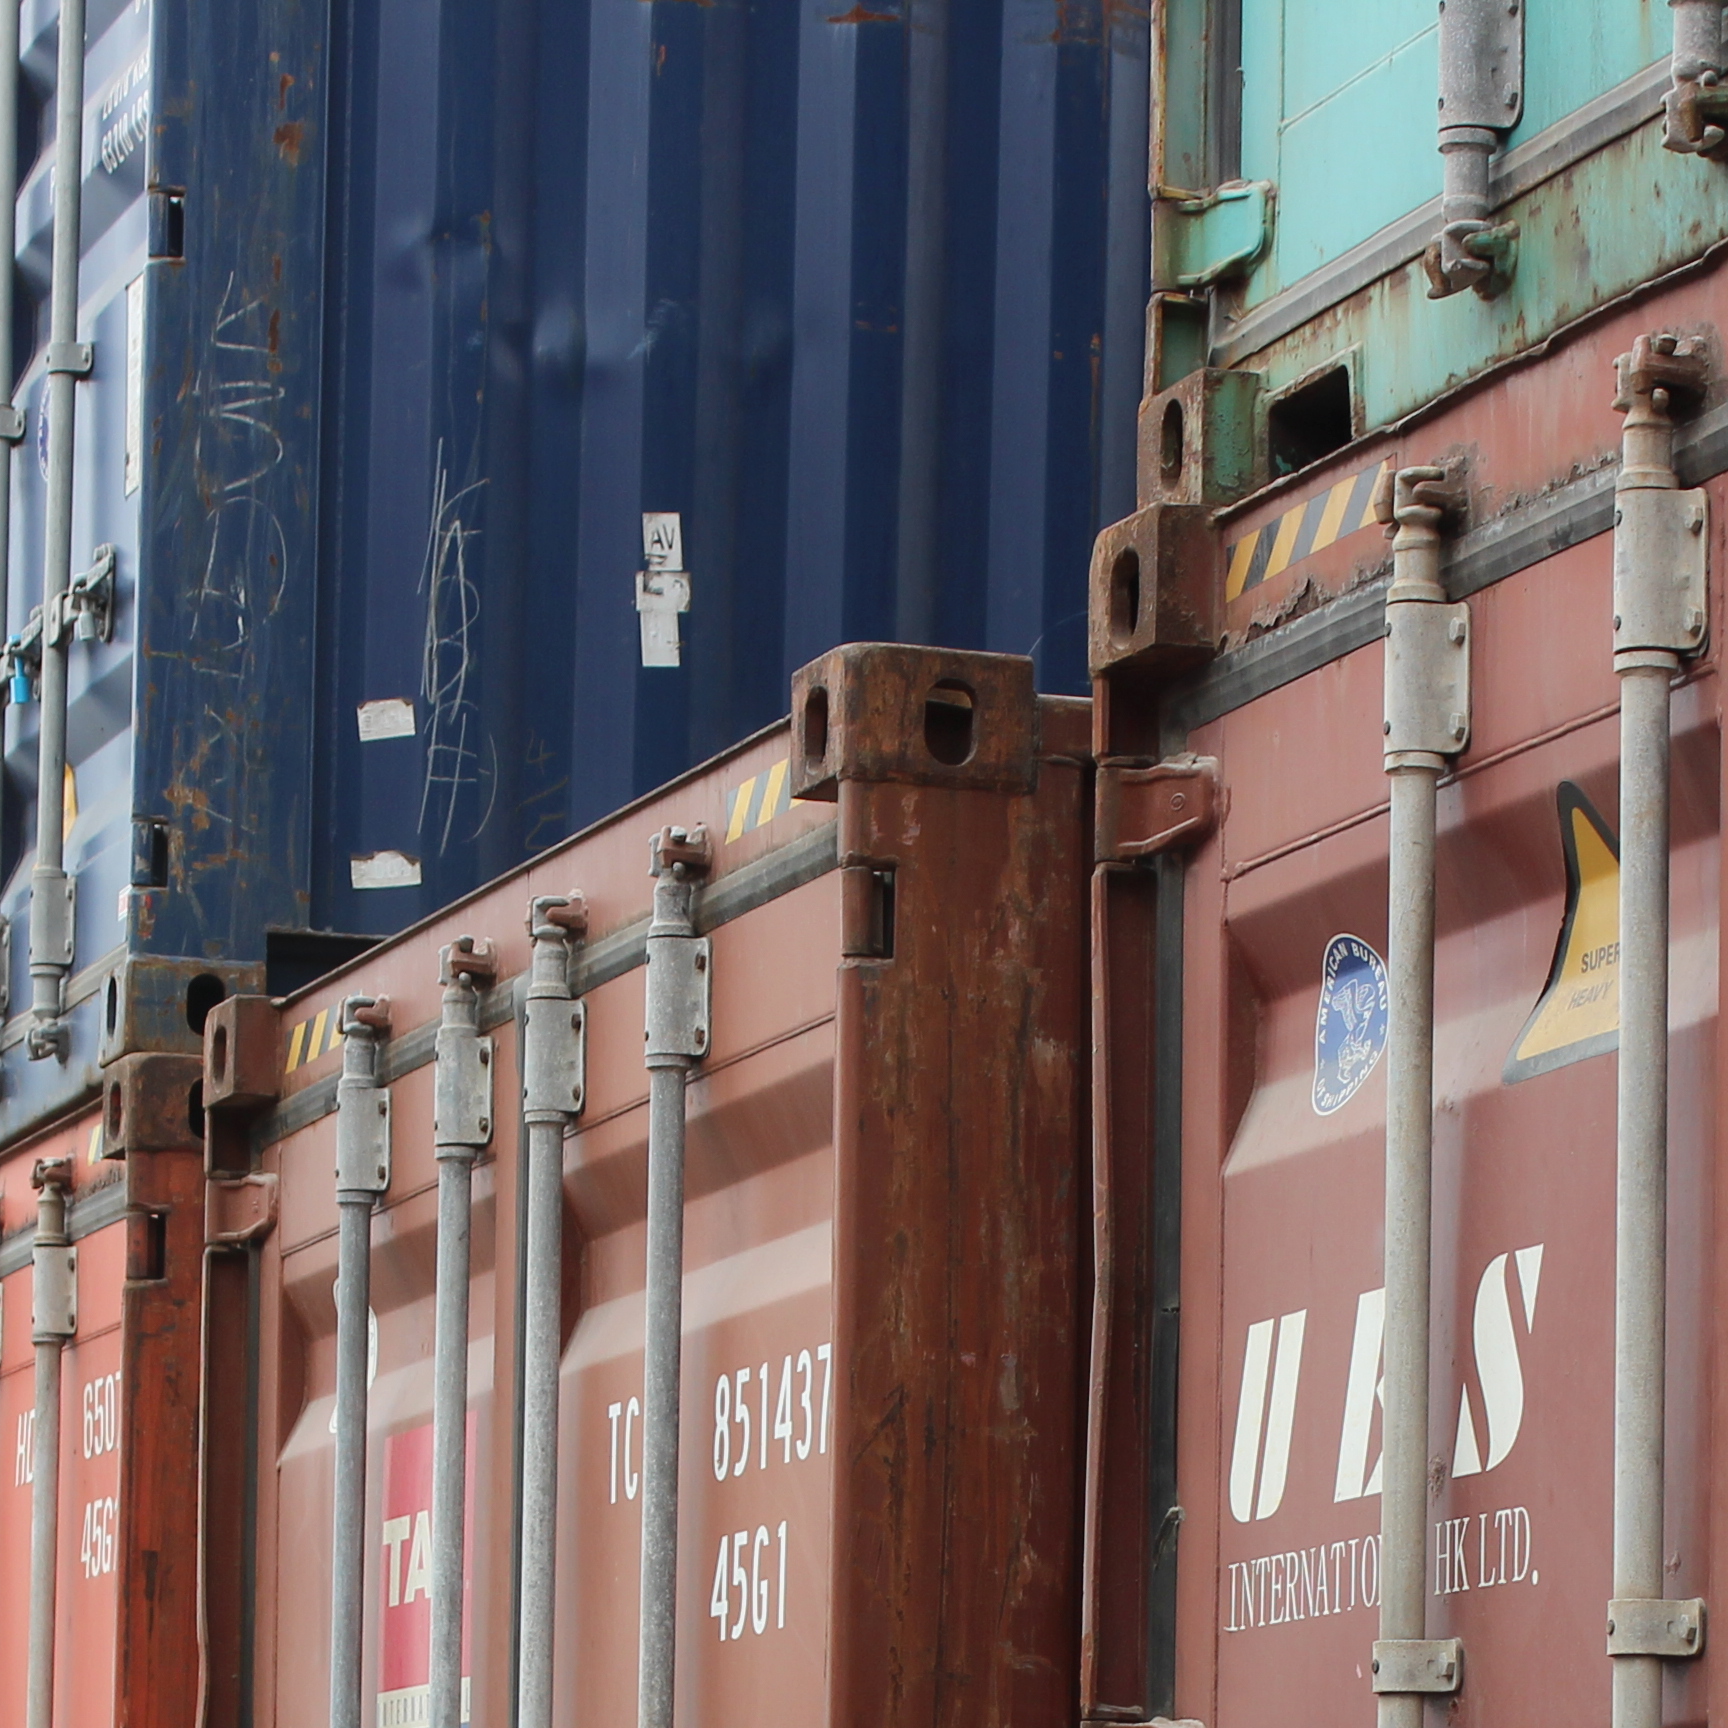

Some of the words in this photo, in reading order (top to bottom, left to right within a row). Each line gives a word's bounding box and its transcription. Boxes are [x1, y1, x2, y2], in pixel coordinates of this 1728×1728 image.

[1319, 941, 1348, 1044] AMERICAN
[1351, 942, 1387, 1011] BUREAU
[1567, 979, 1614, 1011] HEAVY
[1321, 1050, 1379, 1109] SHIPPING
[713, 1342, 831, 1484] 851437
[709, 1519, 788, 1642] 45G1
[1433, 1519, 1470, 1596] HK
[1477, 1507, 1539, 1590] LTD.
